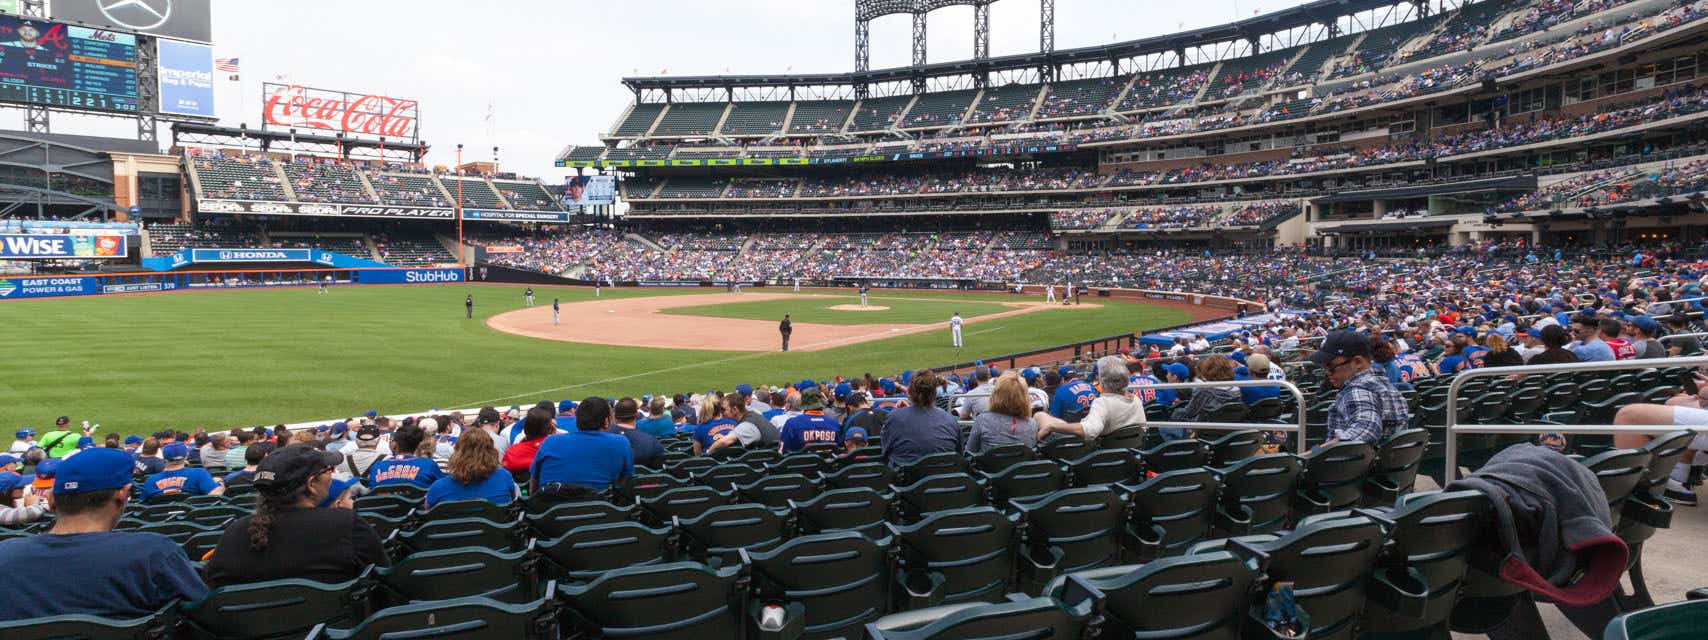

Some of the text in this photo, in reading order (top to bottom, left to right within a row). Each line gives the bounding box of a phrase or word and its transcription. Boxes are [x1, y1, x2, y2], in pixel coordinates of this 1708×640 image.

[342, 207, 453, 217] PRO PLAYER
[232, 251, 287, 259] HONDA
[406, 271, 458, 282] StubHub
[803, 430, 836, 442] OKPOSO
